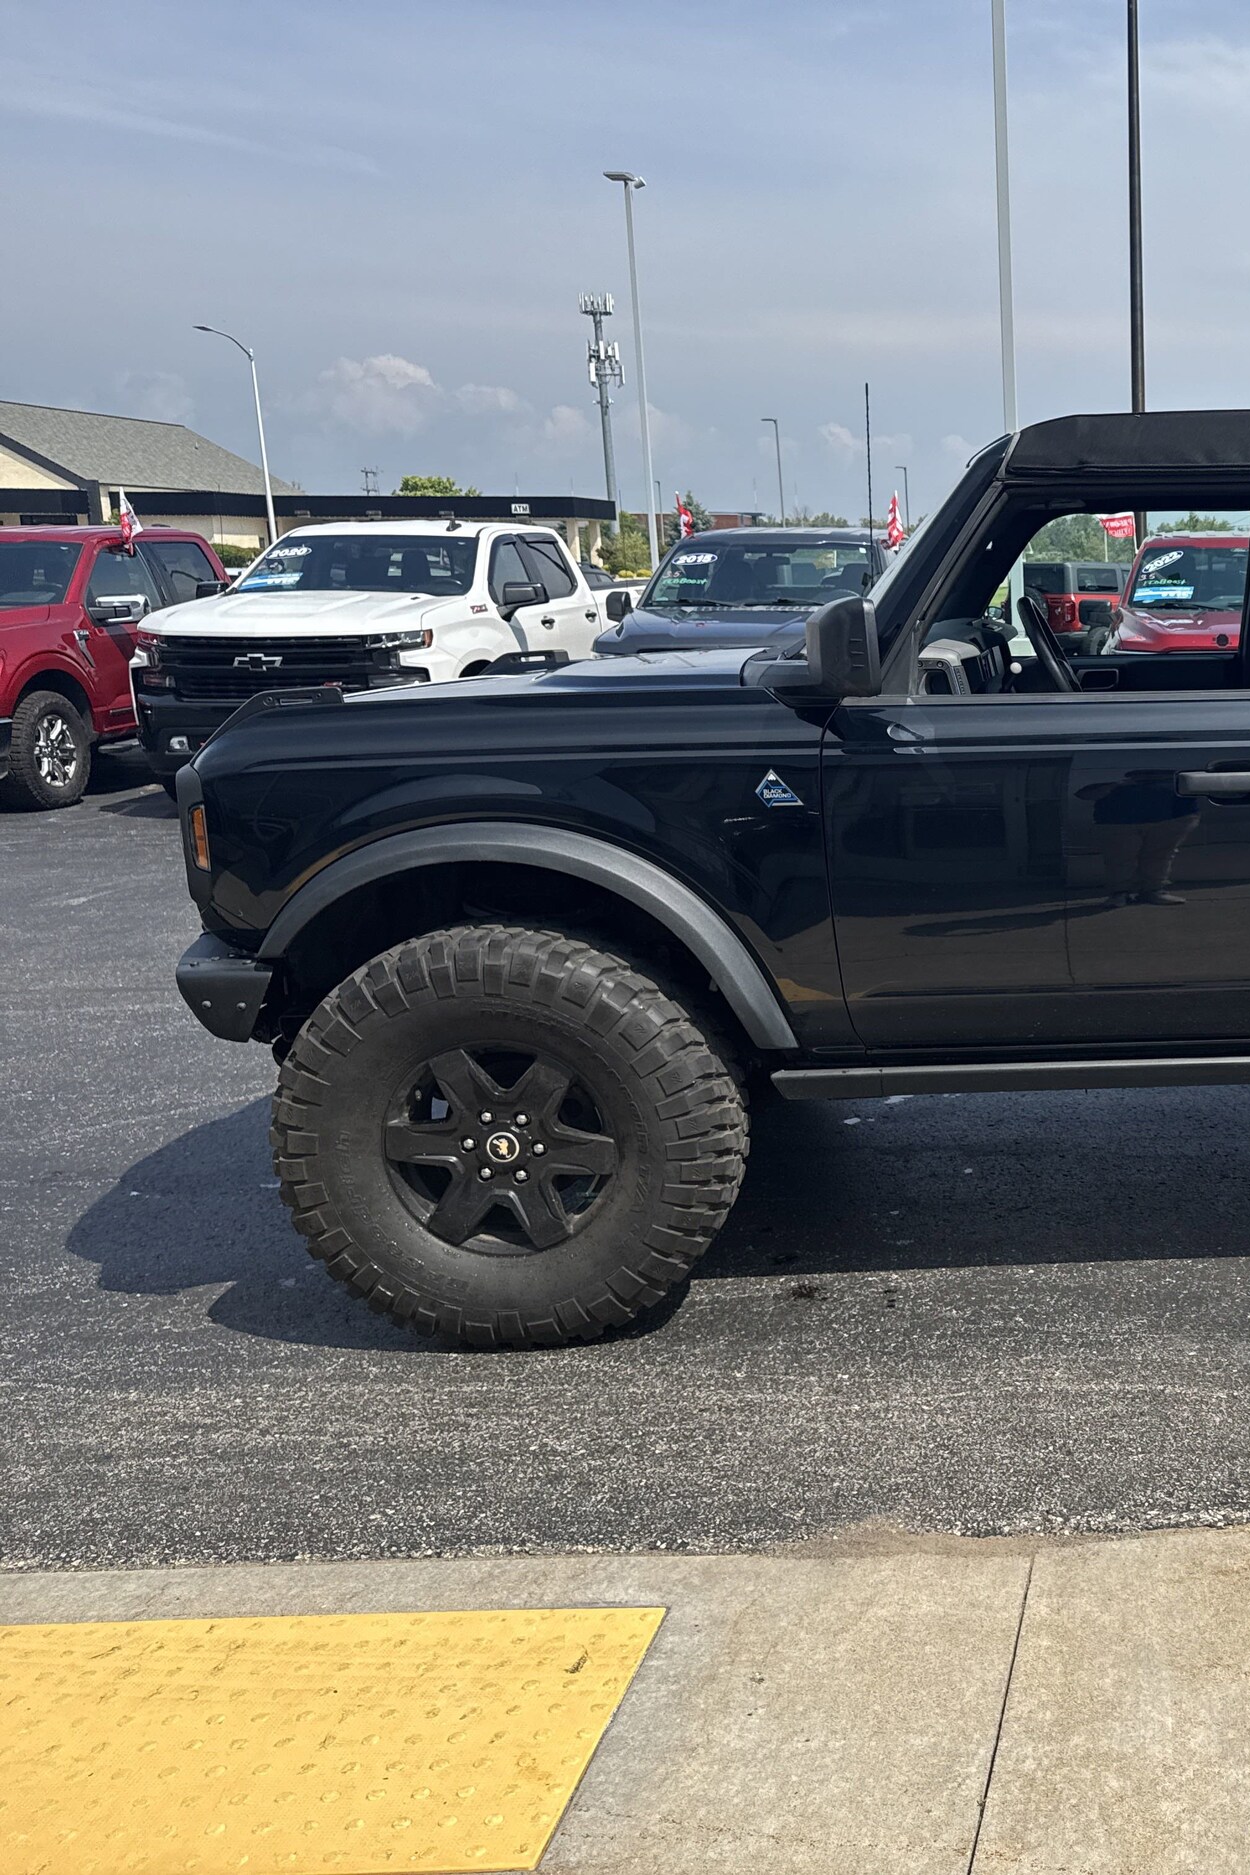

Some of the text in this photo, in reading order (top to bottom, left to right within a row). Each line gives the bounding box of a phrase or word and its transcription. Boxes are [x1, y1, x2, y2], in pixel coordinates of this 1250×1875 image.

[513, 504, 529, 513] ATM
[269, 547, 308, 559] 2020
[676, 554, 712, 565] 2015
[1144, 551, 1181, 573] 2022
